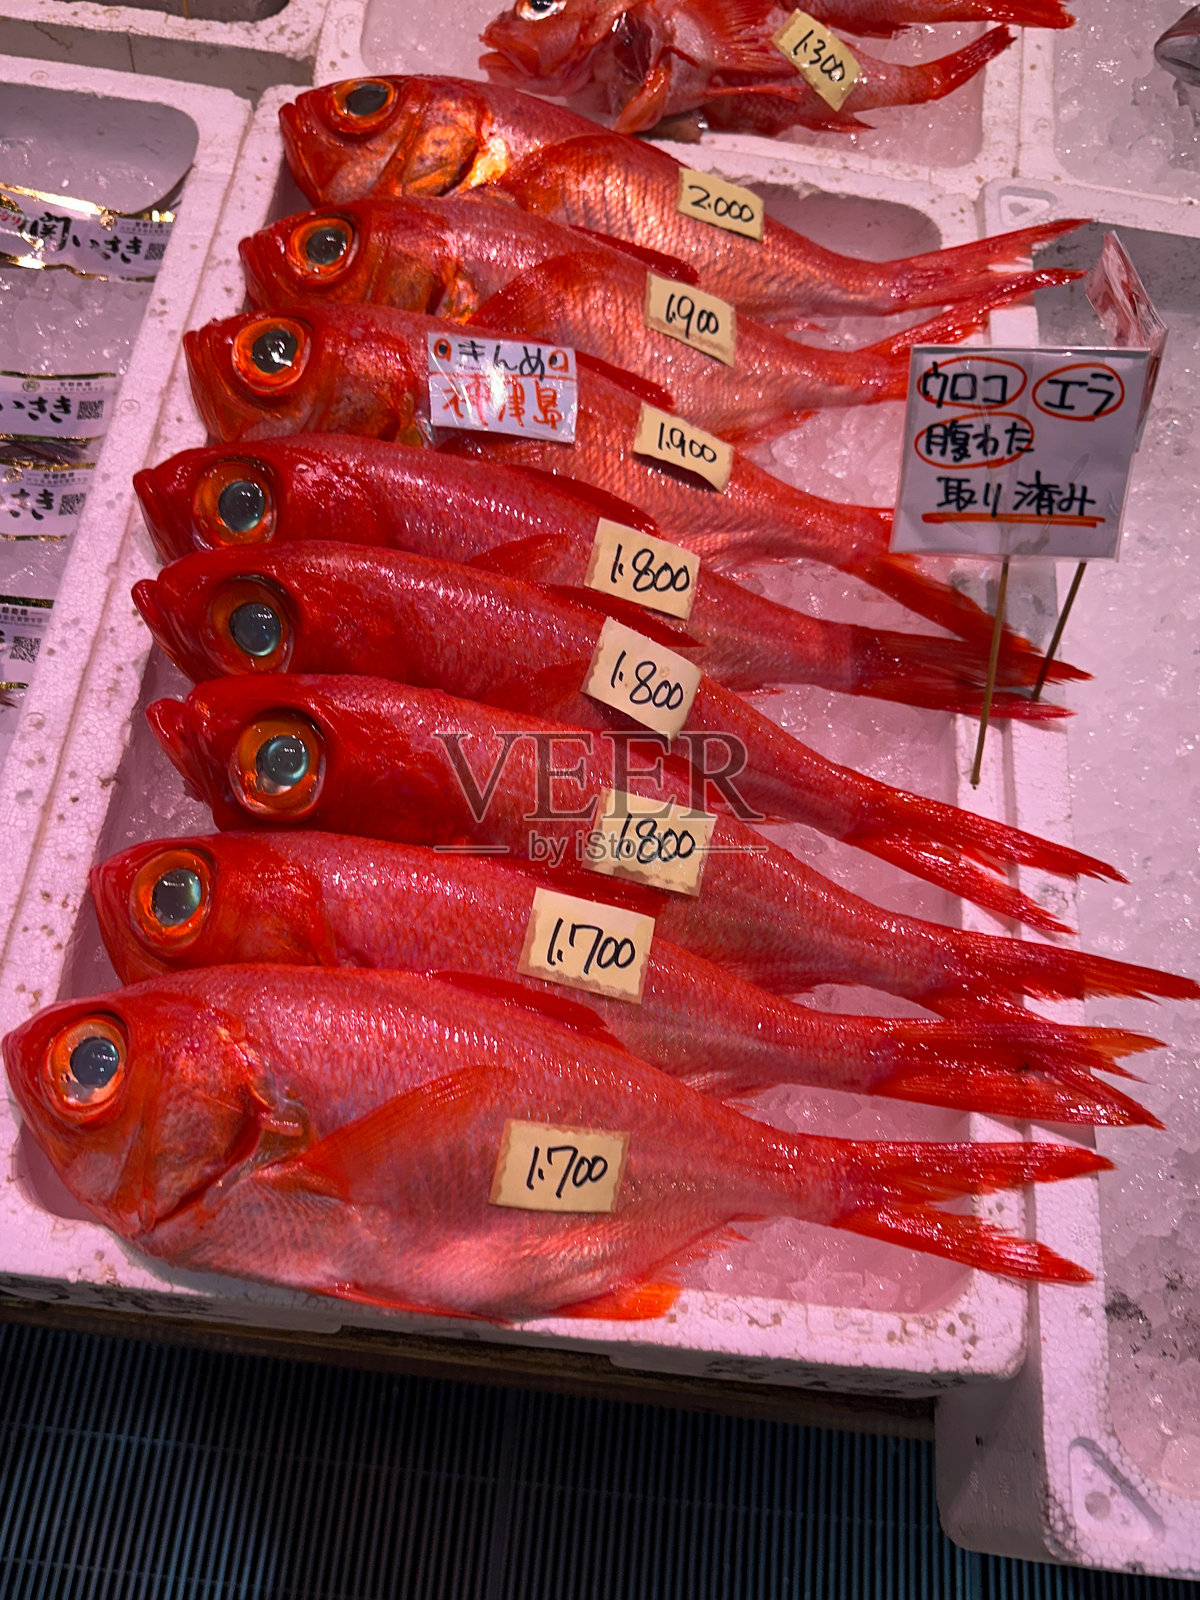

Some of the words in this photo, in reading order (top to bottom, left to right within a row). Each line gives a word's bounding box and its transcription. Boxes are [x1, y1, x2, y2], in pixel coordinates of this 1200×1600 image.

[458, 340, 545, 381] きんめ
[442, 374, 563, 431] 神津島
[922, 362, 1008, 408] ウロコ
[1044, 373, 1115, 416] エラ
[925, 420, 1035, 463] 腹わた
[936, 470, 1096, 518] 取り済み
